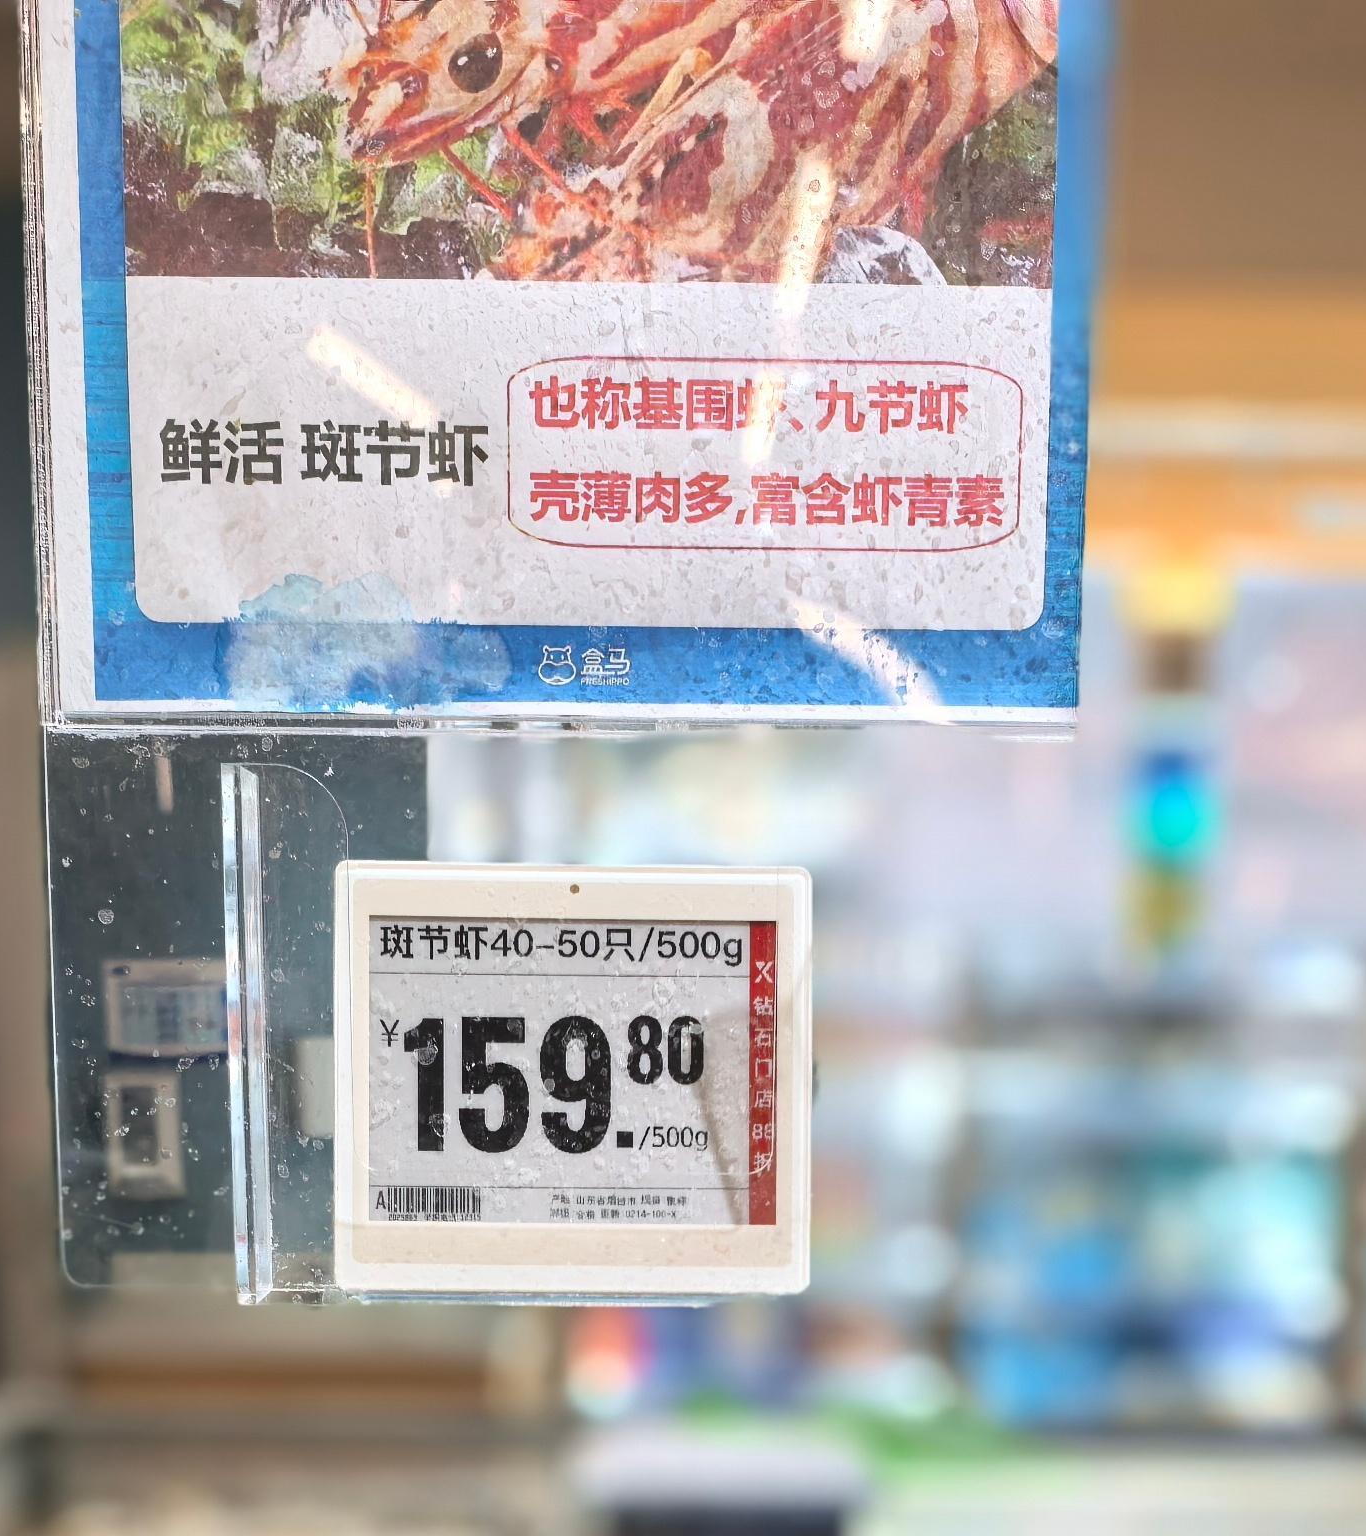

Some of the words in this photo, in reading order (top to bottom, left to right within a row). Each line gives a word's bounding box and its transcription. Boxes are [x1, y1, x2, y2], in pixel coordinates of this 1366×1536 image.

[159, 418, 284, 485] 鲜活
[300, 418, 489, 487] 斑节虾
[581, 645, 631, 675] 盒马
